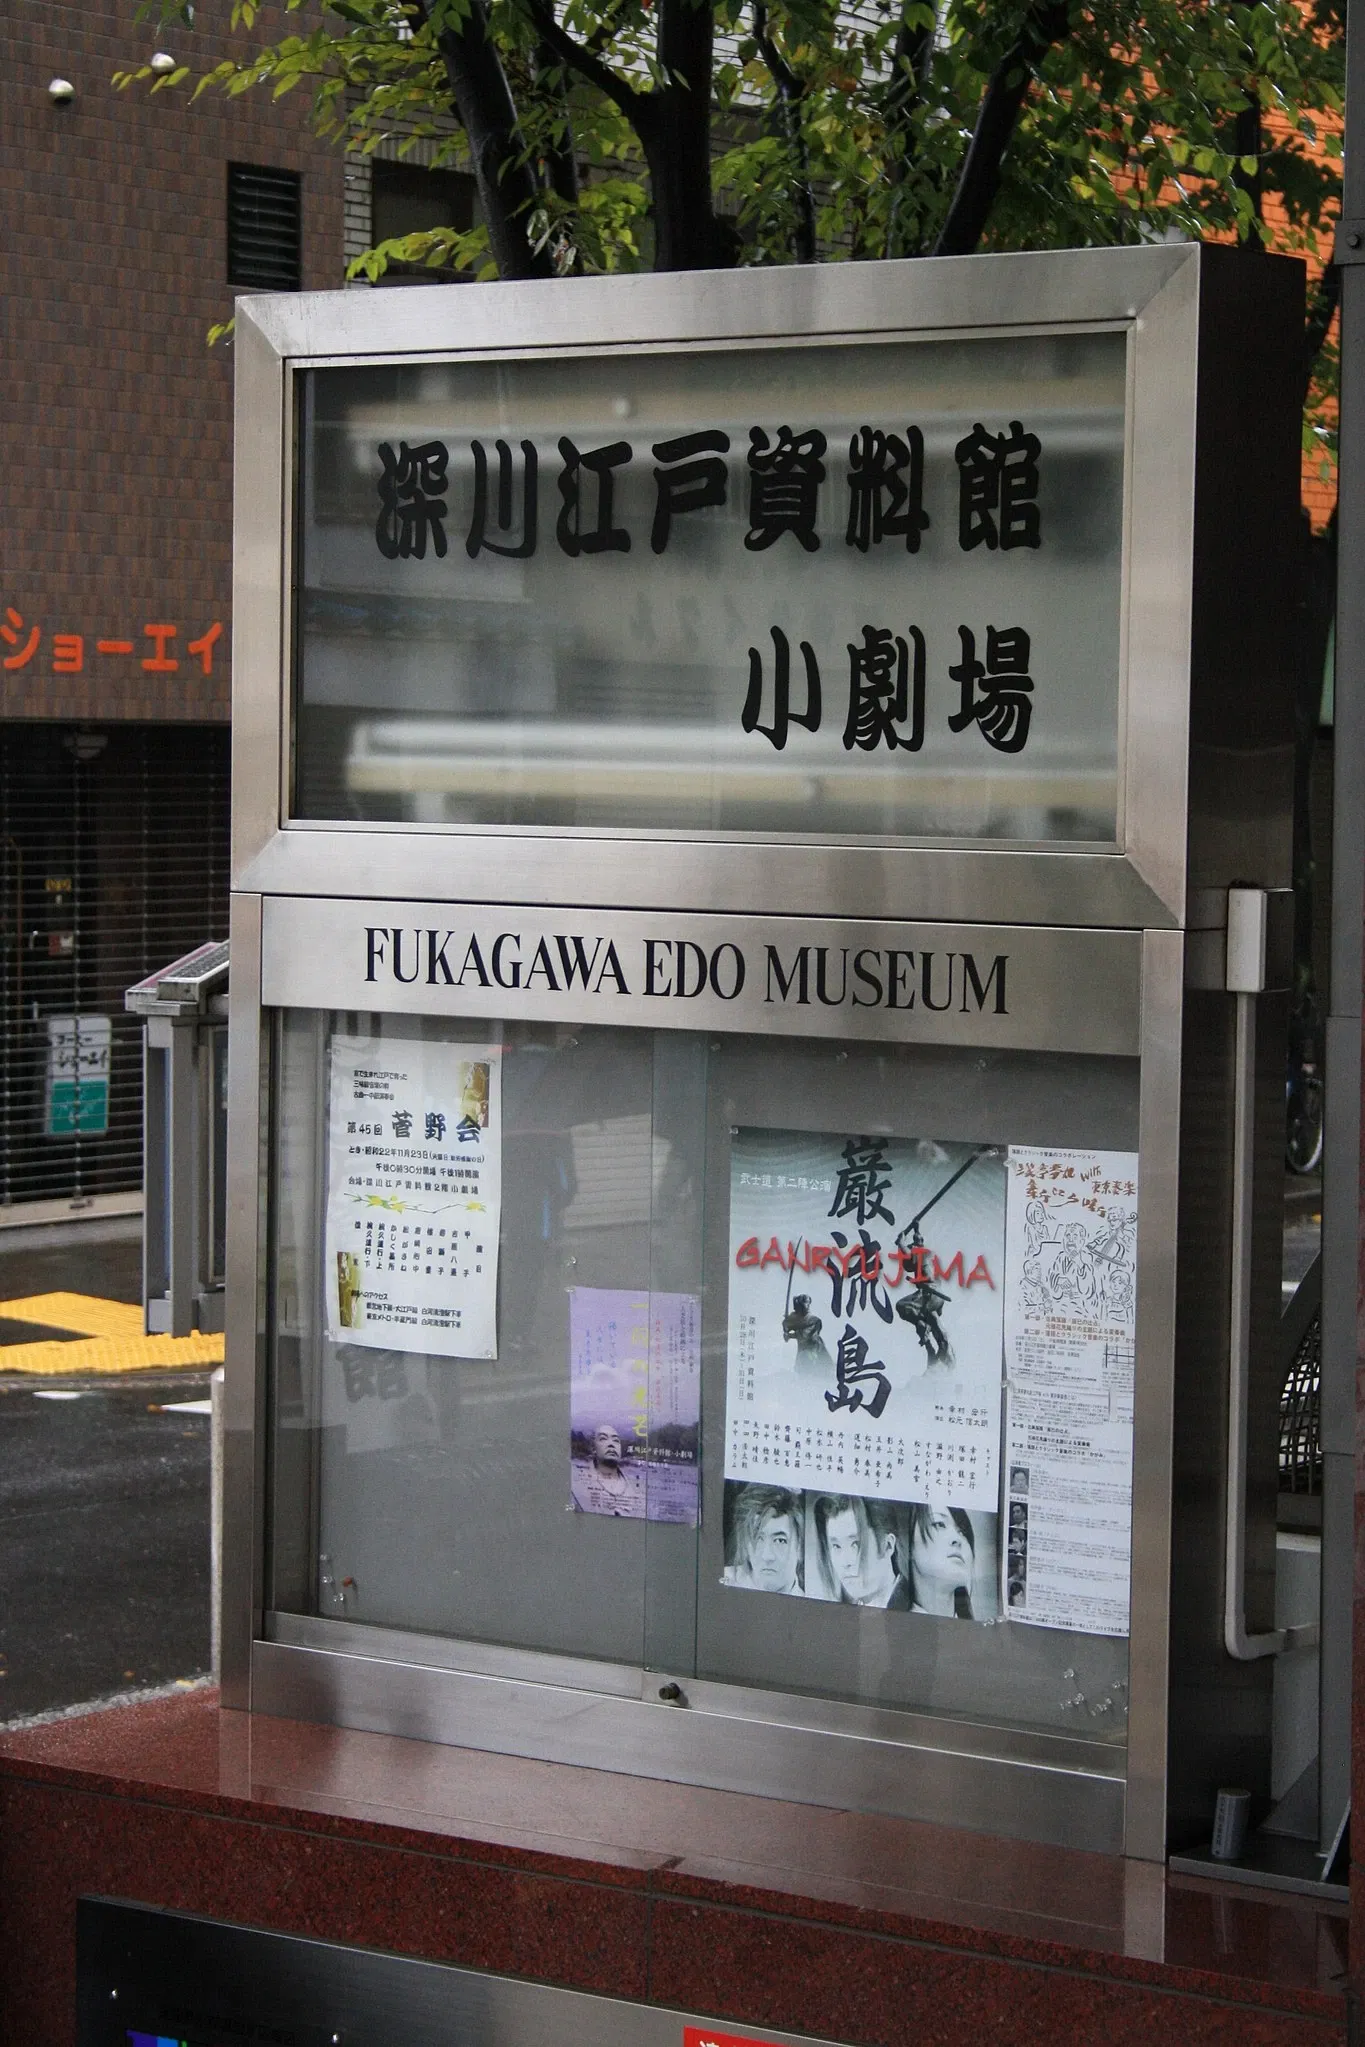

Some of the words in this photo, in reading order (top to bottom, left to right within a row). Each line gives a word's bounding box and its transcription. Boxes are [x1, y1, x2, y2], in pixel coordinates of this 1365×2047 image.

[375, 421, 1042, 559] 深川江戸資料館
[0, 608, 223, 676] ショーエイ
[741, 625, 1035, 753] 小劇場
[363, 926, 632, 995] FUKAGAWA
[642, 938, 746, 1000] EDO
[764, 944, 1010, 1015] MUSEUM
[347, 1121, 383, 1136] 第45回
[391, 1109, 482, 1144] 菅野会
[825, 1135, 897, 1420] 巌流島
